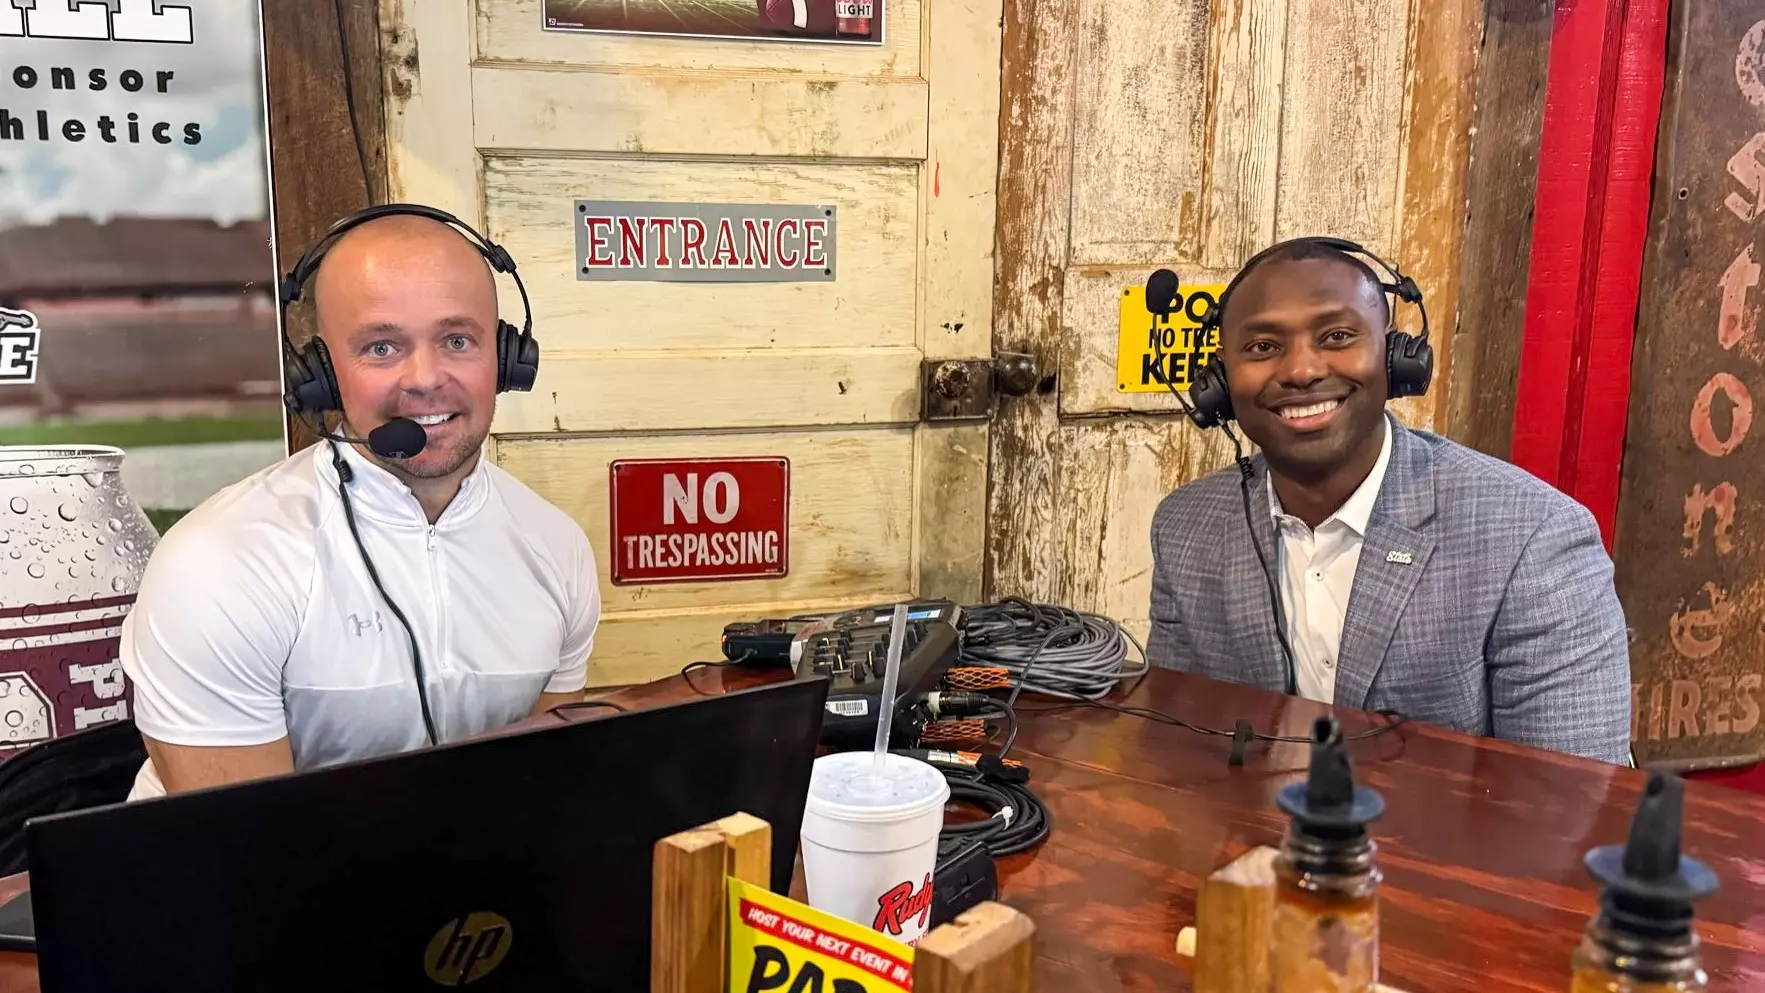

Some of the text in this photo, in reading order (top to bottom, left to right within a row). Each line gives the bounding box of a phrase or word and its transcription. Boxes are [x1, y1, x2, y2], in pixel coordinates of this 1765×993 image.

[838, 4, 871, 15] LIGHT
[13, 65, 174, 93] onsor
[0, 109, 202, 145] hletics
[585, 216, 828, 269] ENTRANCE
[1149, 328, 1222, 348] NO TRE
[663, 471, 740, 525] NO
[623, 530, 778, 569] TRESPASSING
[425, 911, 512, 986] hp
[748, 907, 909, 982] HOST YOUR NEXT EVENT IN
